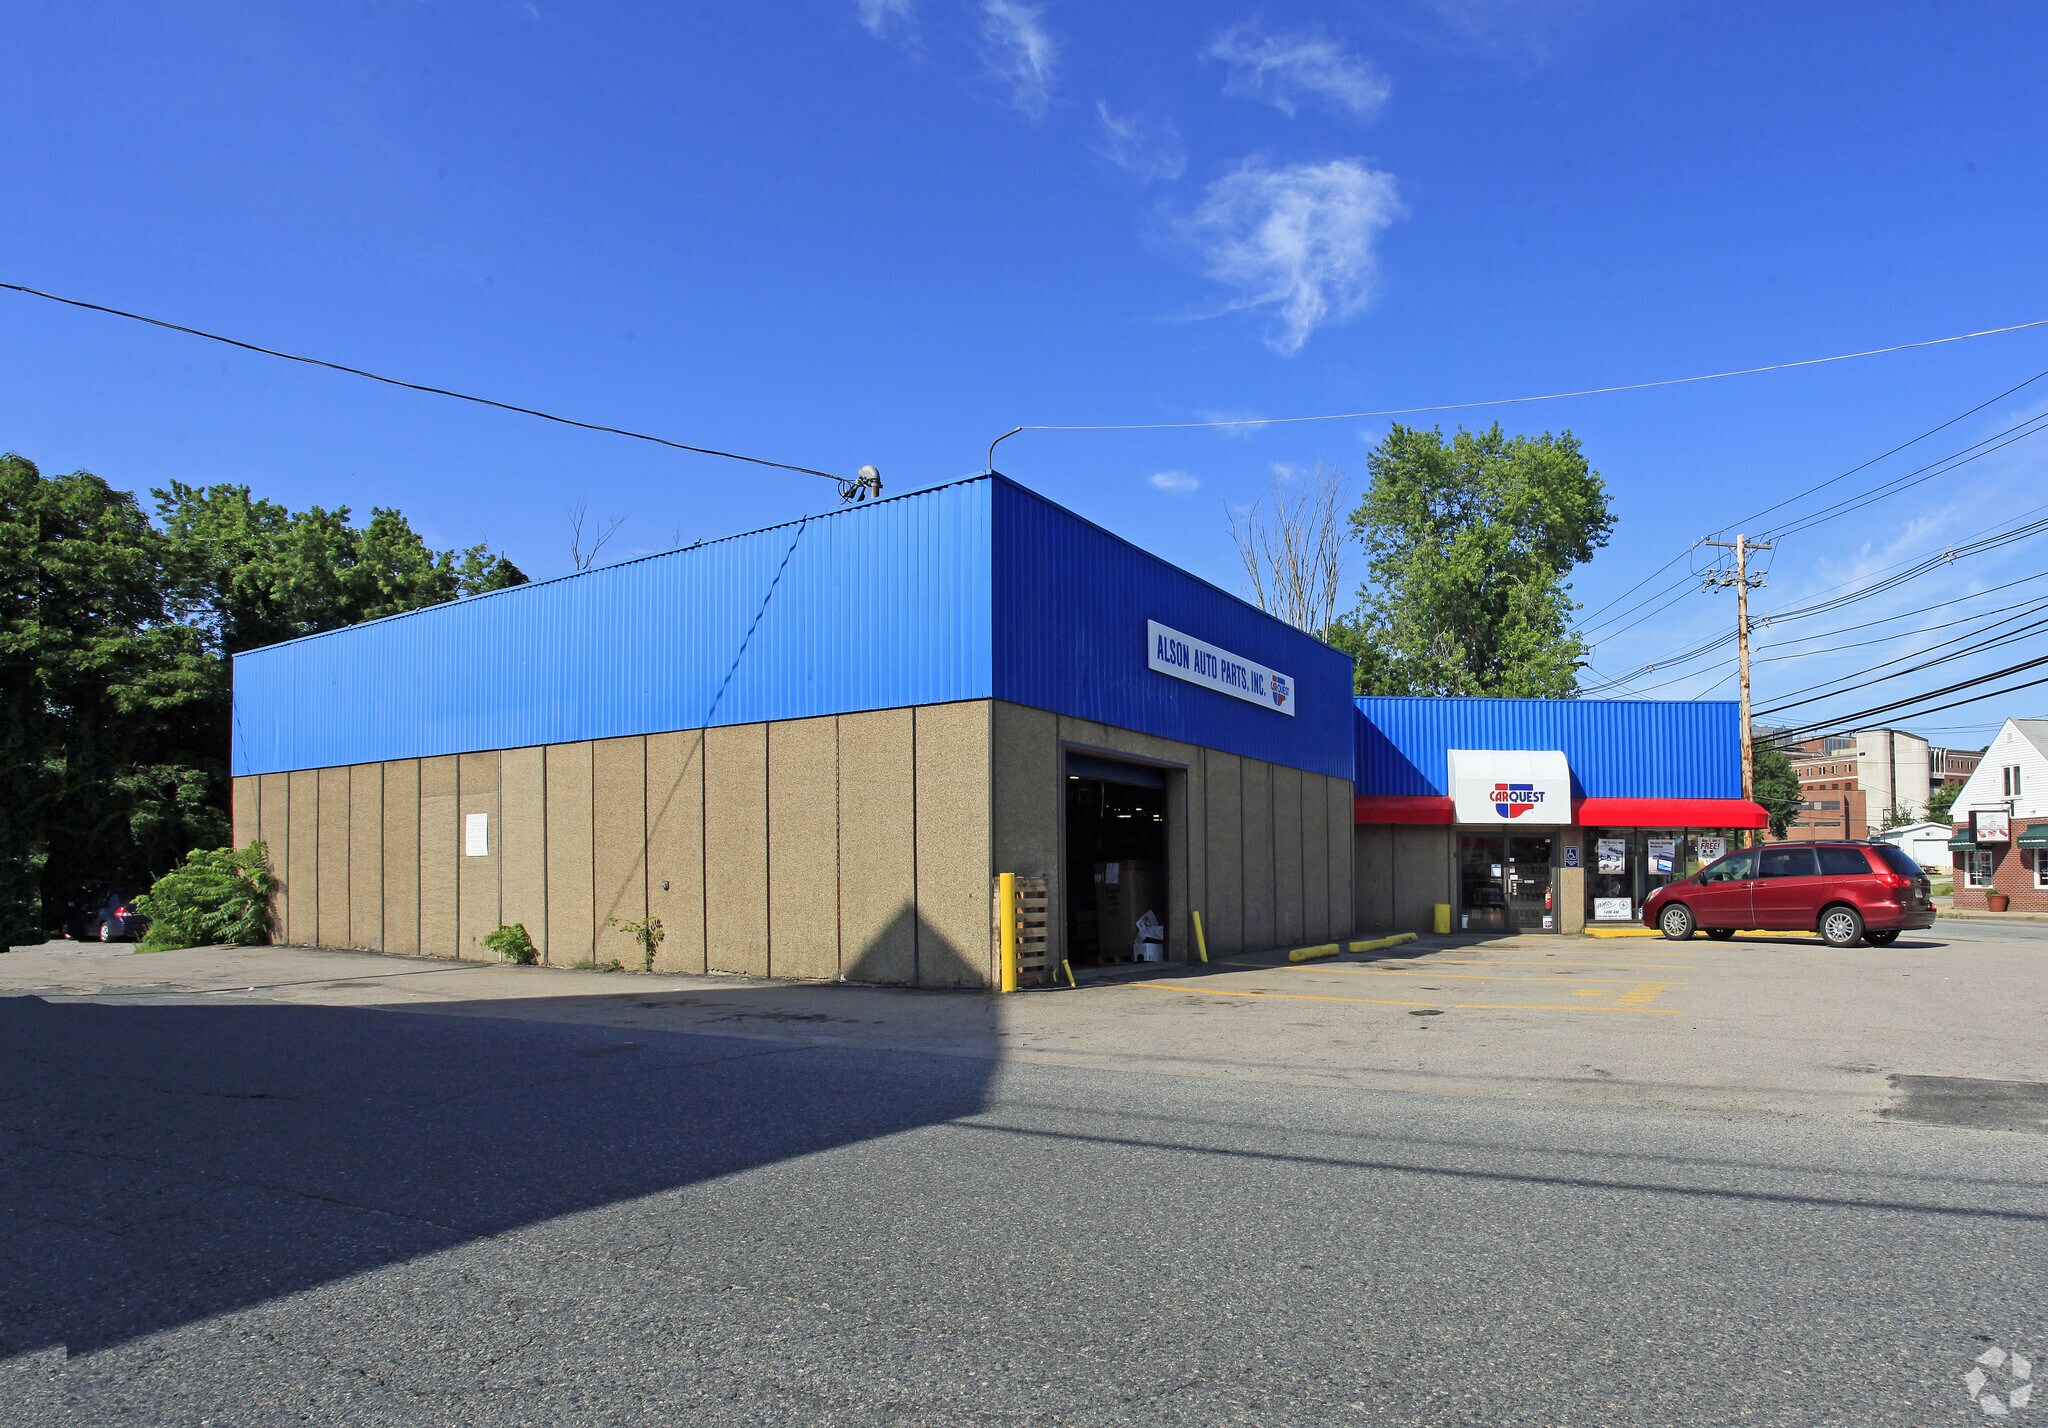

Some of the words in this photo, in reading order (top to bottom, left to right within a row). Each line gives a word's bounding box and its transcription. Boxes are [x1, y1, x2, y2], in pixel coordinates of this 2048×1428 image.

[1157, 634, 1190, 669] ALSON
[1194, 648, 1217, 679] AUTO
[1221, 658, 1249, 693] PARTS,
[1251, 670, 1266, 697] INC.
[1489, 790, 1546, 803] CARQUEST
[1700, 842, 1720, 850] FREE!
